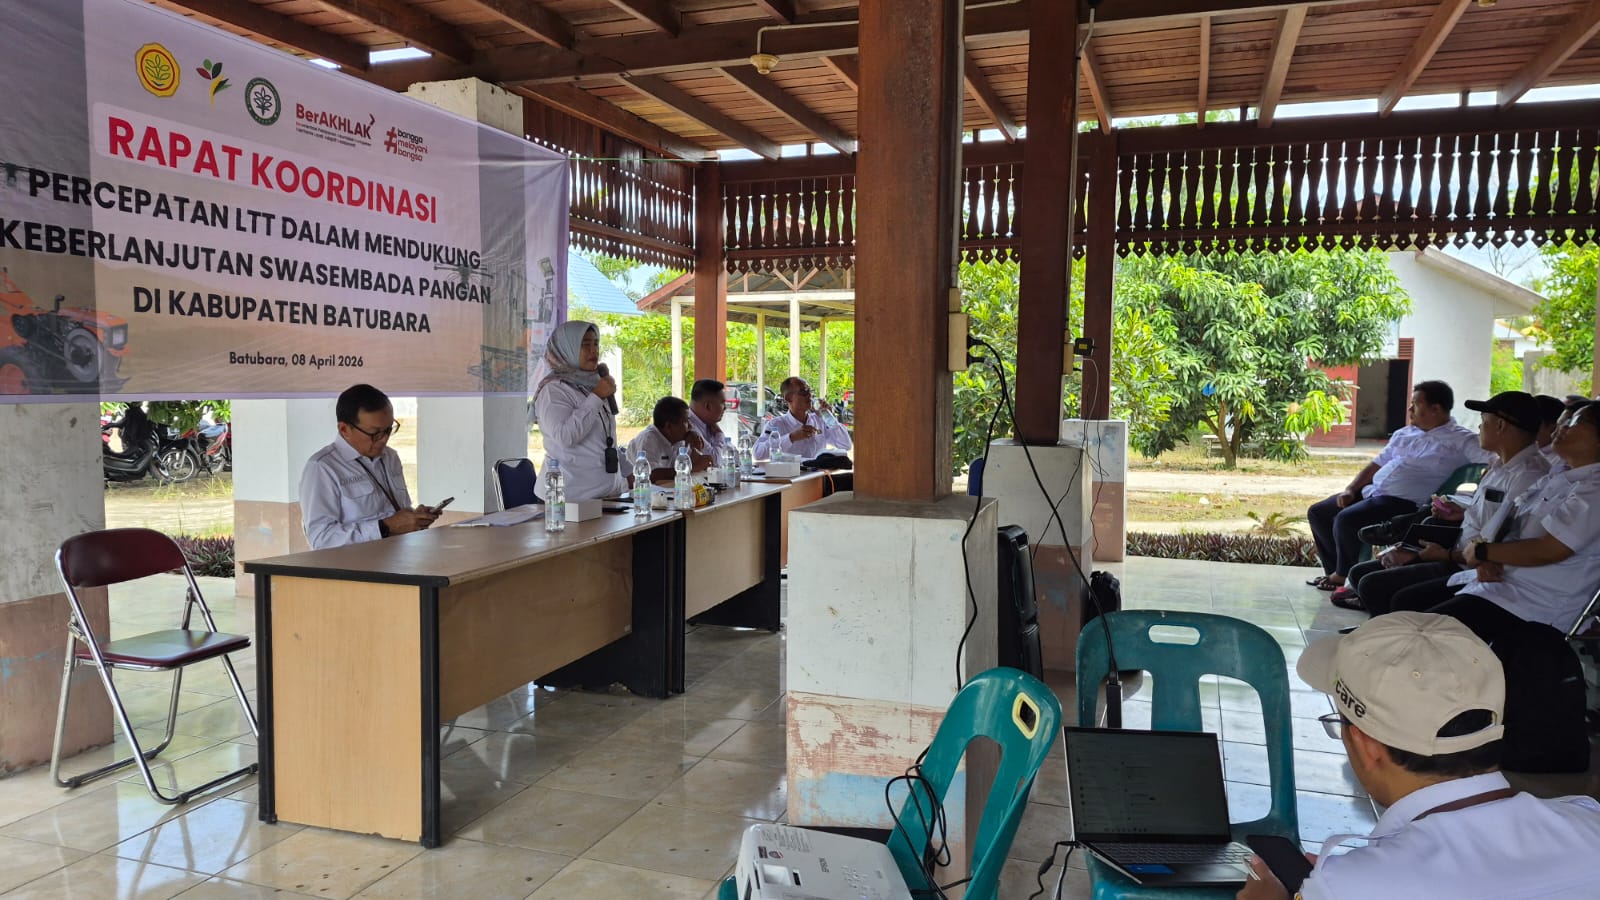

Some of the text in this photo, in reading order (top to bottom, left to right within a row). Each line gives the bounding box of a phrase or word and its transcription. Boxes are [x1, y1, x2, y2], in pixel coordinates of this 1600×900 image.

[296, 103, 372, 139] BerAKHLAK
[397, 128, 424, 144] bangga
[109, 117, 437, 223] RAPAT KOORDINASI
[397, 149, 423, 162] bangsa
[29, 167, 481, 270] PERCEPATAN LTT DALAM MENDUKUNG
[0, 217, 491, 305] KEBERLANJUTAN SWASEMBADA PANGAN
[133, 286, 431, 333] DI KABUPATEN BATUBARA
[229, 351, 364, 370] Batubara, 08 April 2026
[1335, 680, 1366, 718] care
